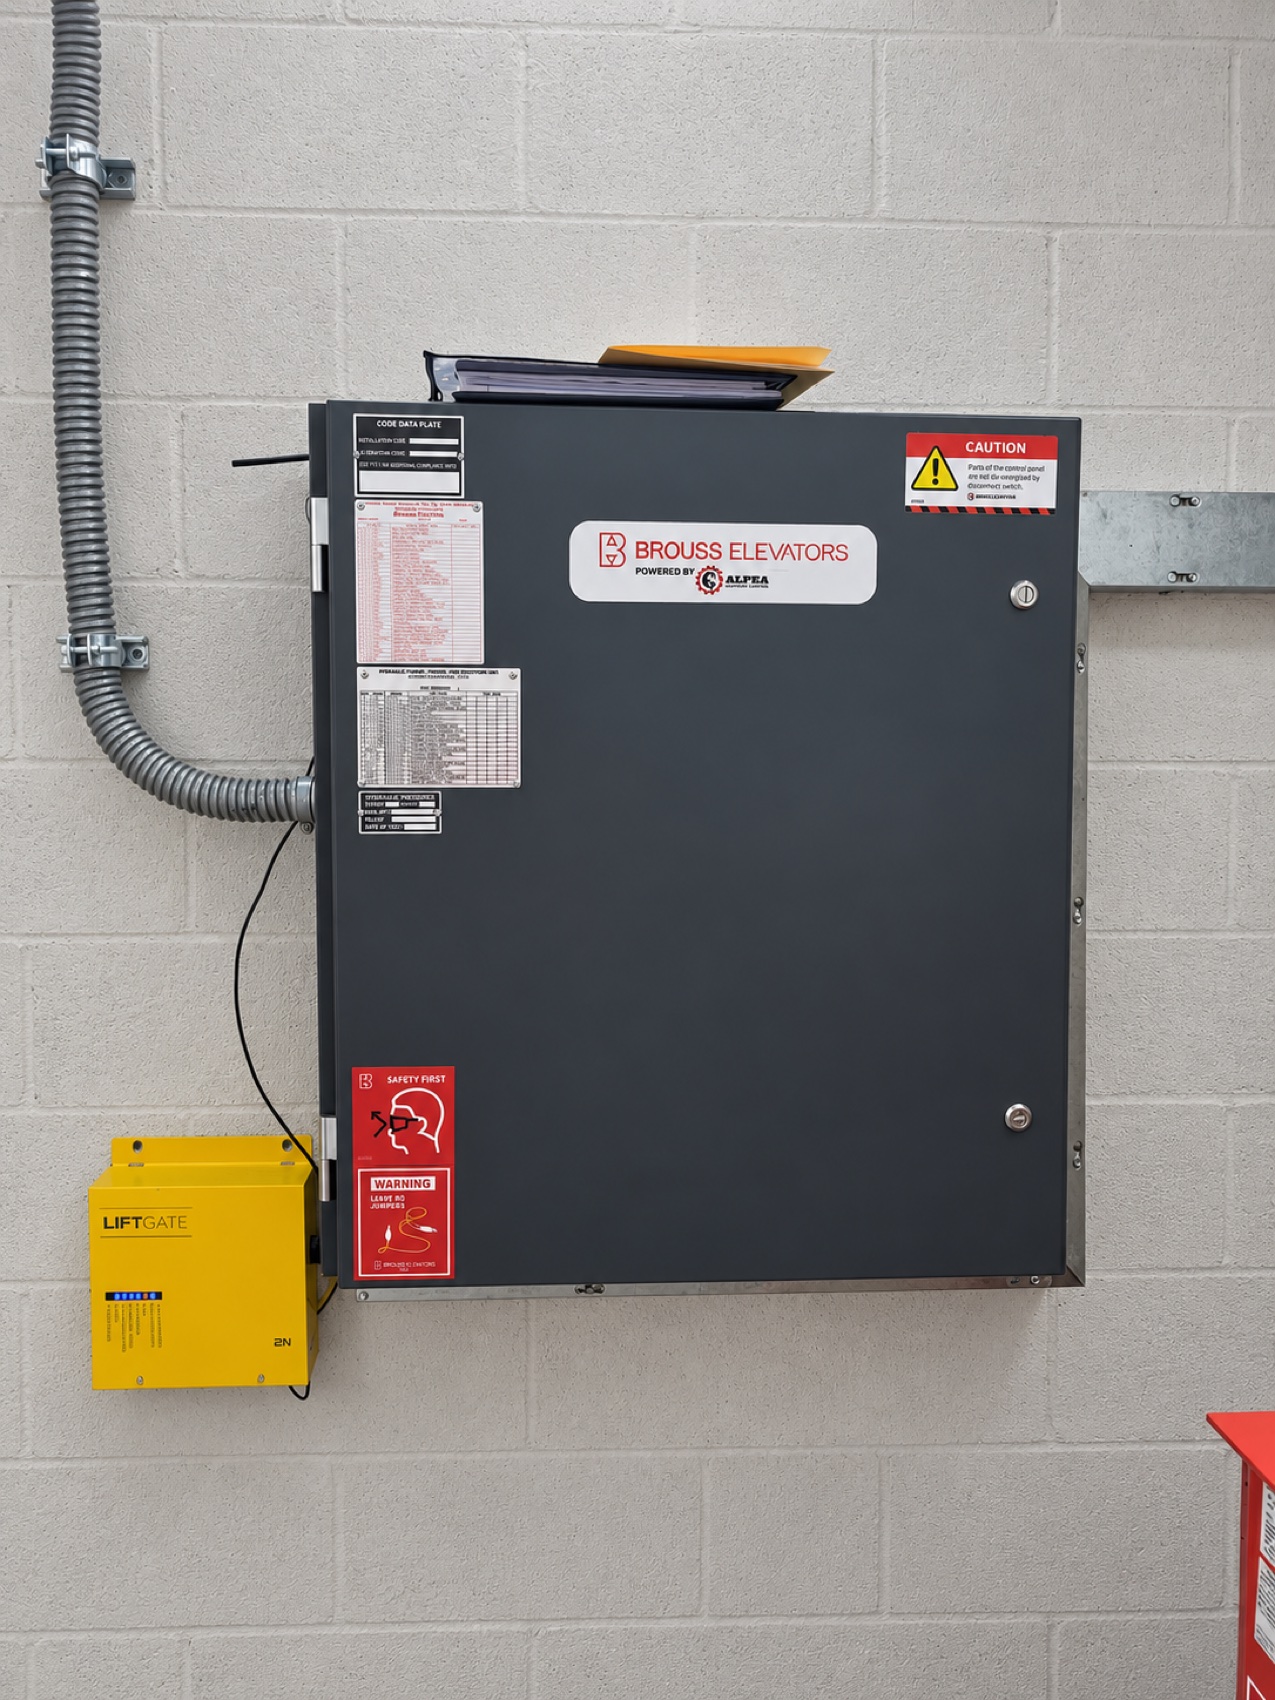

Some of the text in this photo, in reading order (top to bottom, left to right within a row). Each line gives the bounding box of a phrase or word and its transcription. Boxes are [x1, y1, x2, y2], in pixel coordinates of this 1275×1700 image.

[376, 419, 442, 429] CODE DATA PLATE
[965, 441, 1026, 454] CAUTION
[635, 540, 849, 562] BROUSS ELEVATORS
[635, 567, 695, 577] POWERED BY
[387, 1075, 419, 1084] SAFETY
[421, 1075, 446, 1084] FIRST
[374, 1179, 431, 1189] WARNING
[103, 1215, 188, 1230] LIFTGATE
[274, 1337, 291, 1347] 2N
